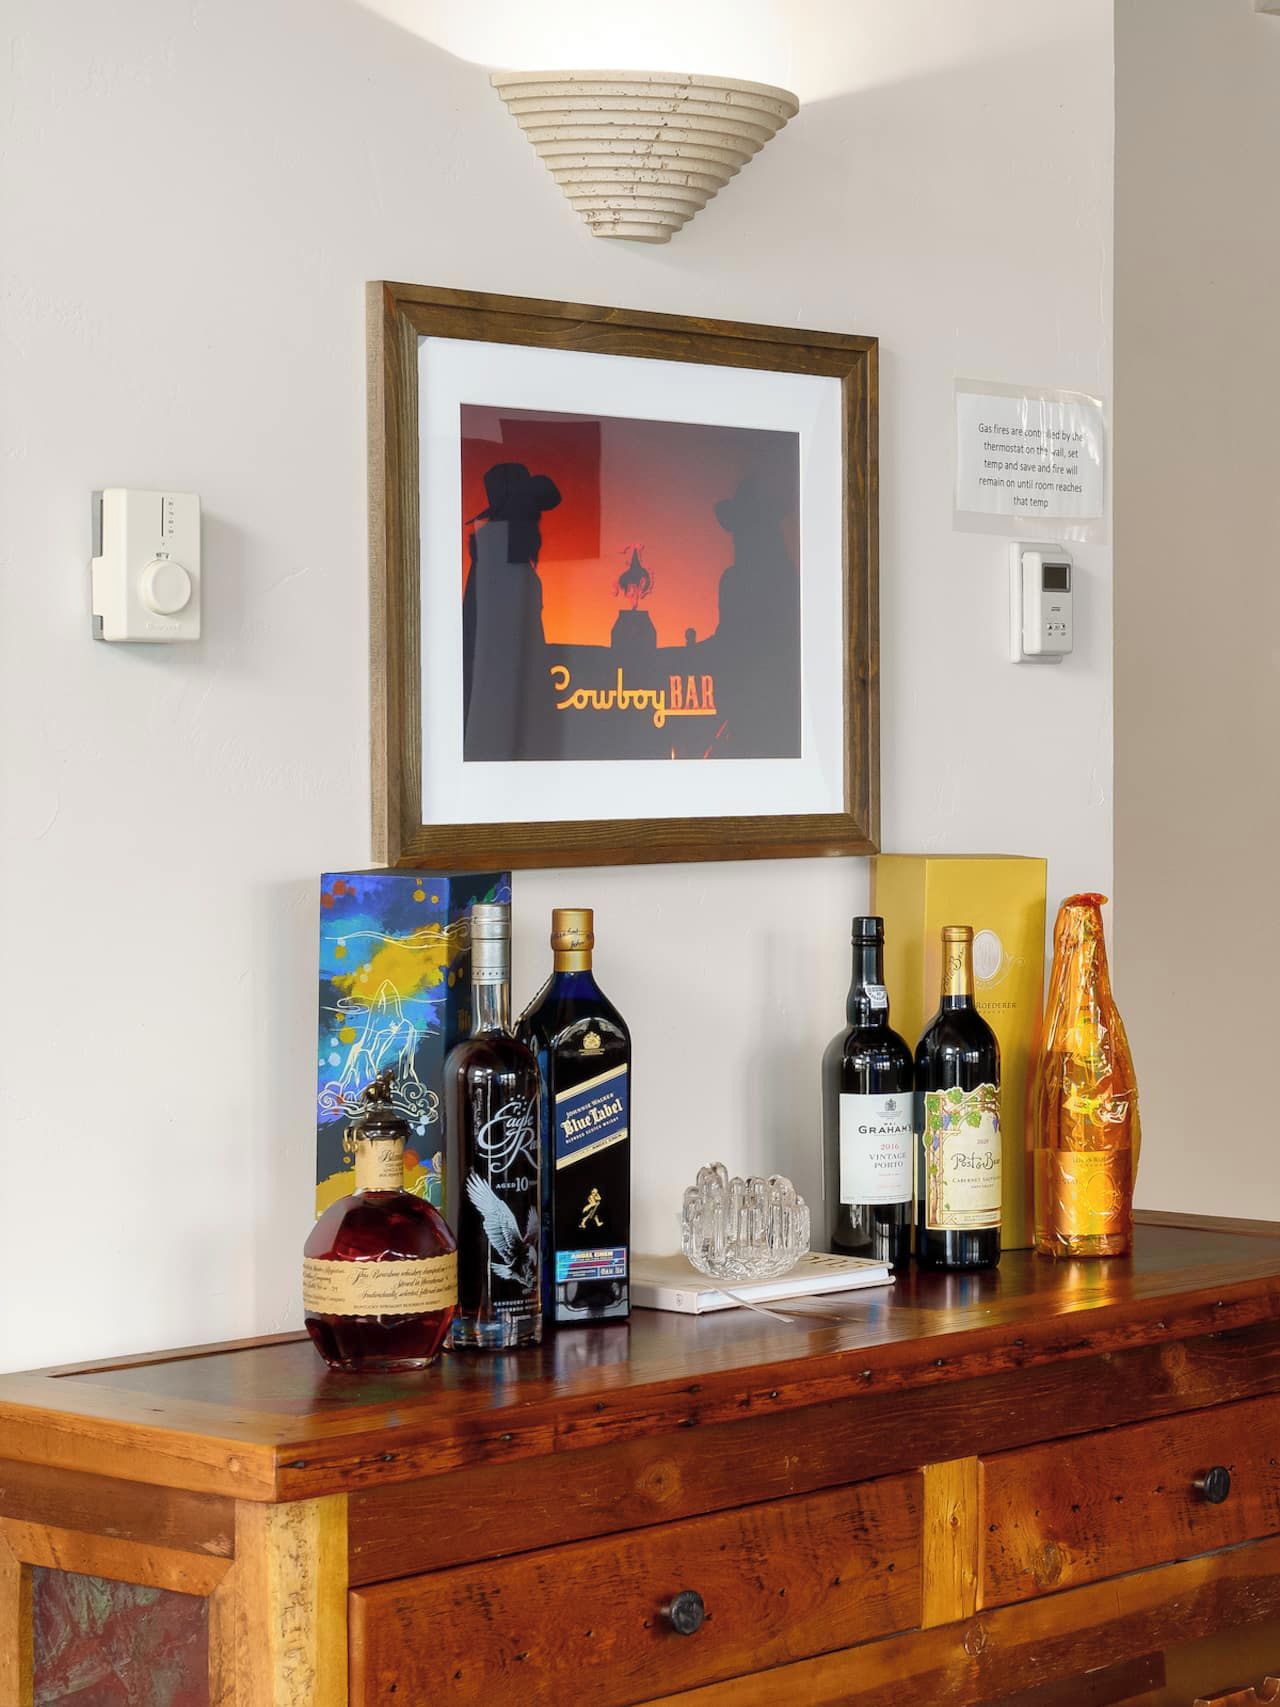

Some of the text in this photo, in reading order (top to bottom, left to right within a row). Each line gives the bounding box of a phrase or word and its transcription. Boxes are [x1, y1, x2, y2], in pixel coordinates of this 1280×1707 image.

[978, 422, 992, 433] Gas
[993, 424, 1009, 435] fires
[1011, 427, 1023, 436] are
[1024, 428, 1060, 440] contlled
[1061, 429, 1071, 442] by
[983, 441, 1024, 454] thermostat
[1025, 446, 1036, 455] on
[1067, 449, 1079, 458] set
[983, 459, 1078, 475] temp and save and fire will
[978, 477, 1082, 493] remain on until room reaches
[1013, 495, 1048, 509] that temp
[549, 664, 716, 729] Cowboy BAR
[560, 1098, 624, 1138] Blue Label
[868, 1152, 906, 1161] VINTAGE
[874, 1161, 904, 1169] PORTO
[495, 1182, 516, 1190] AGED
[515, 1176, 529, 1192] 10
